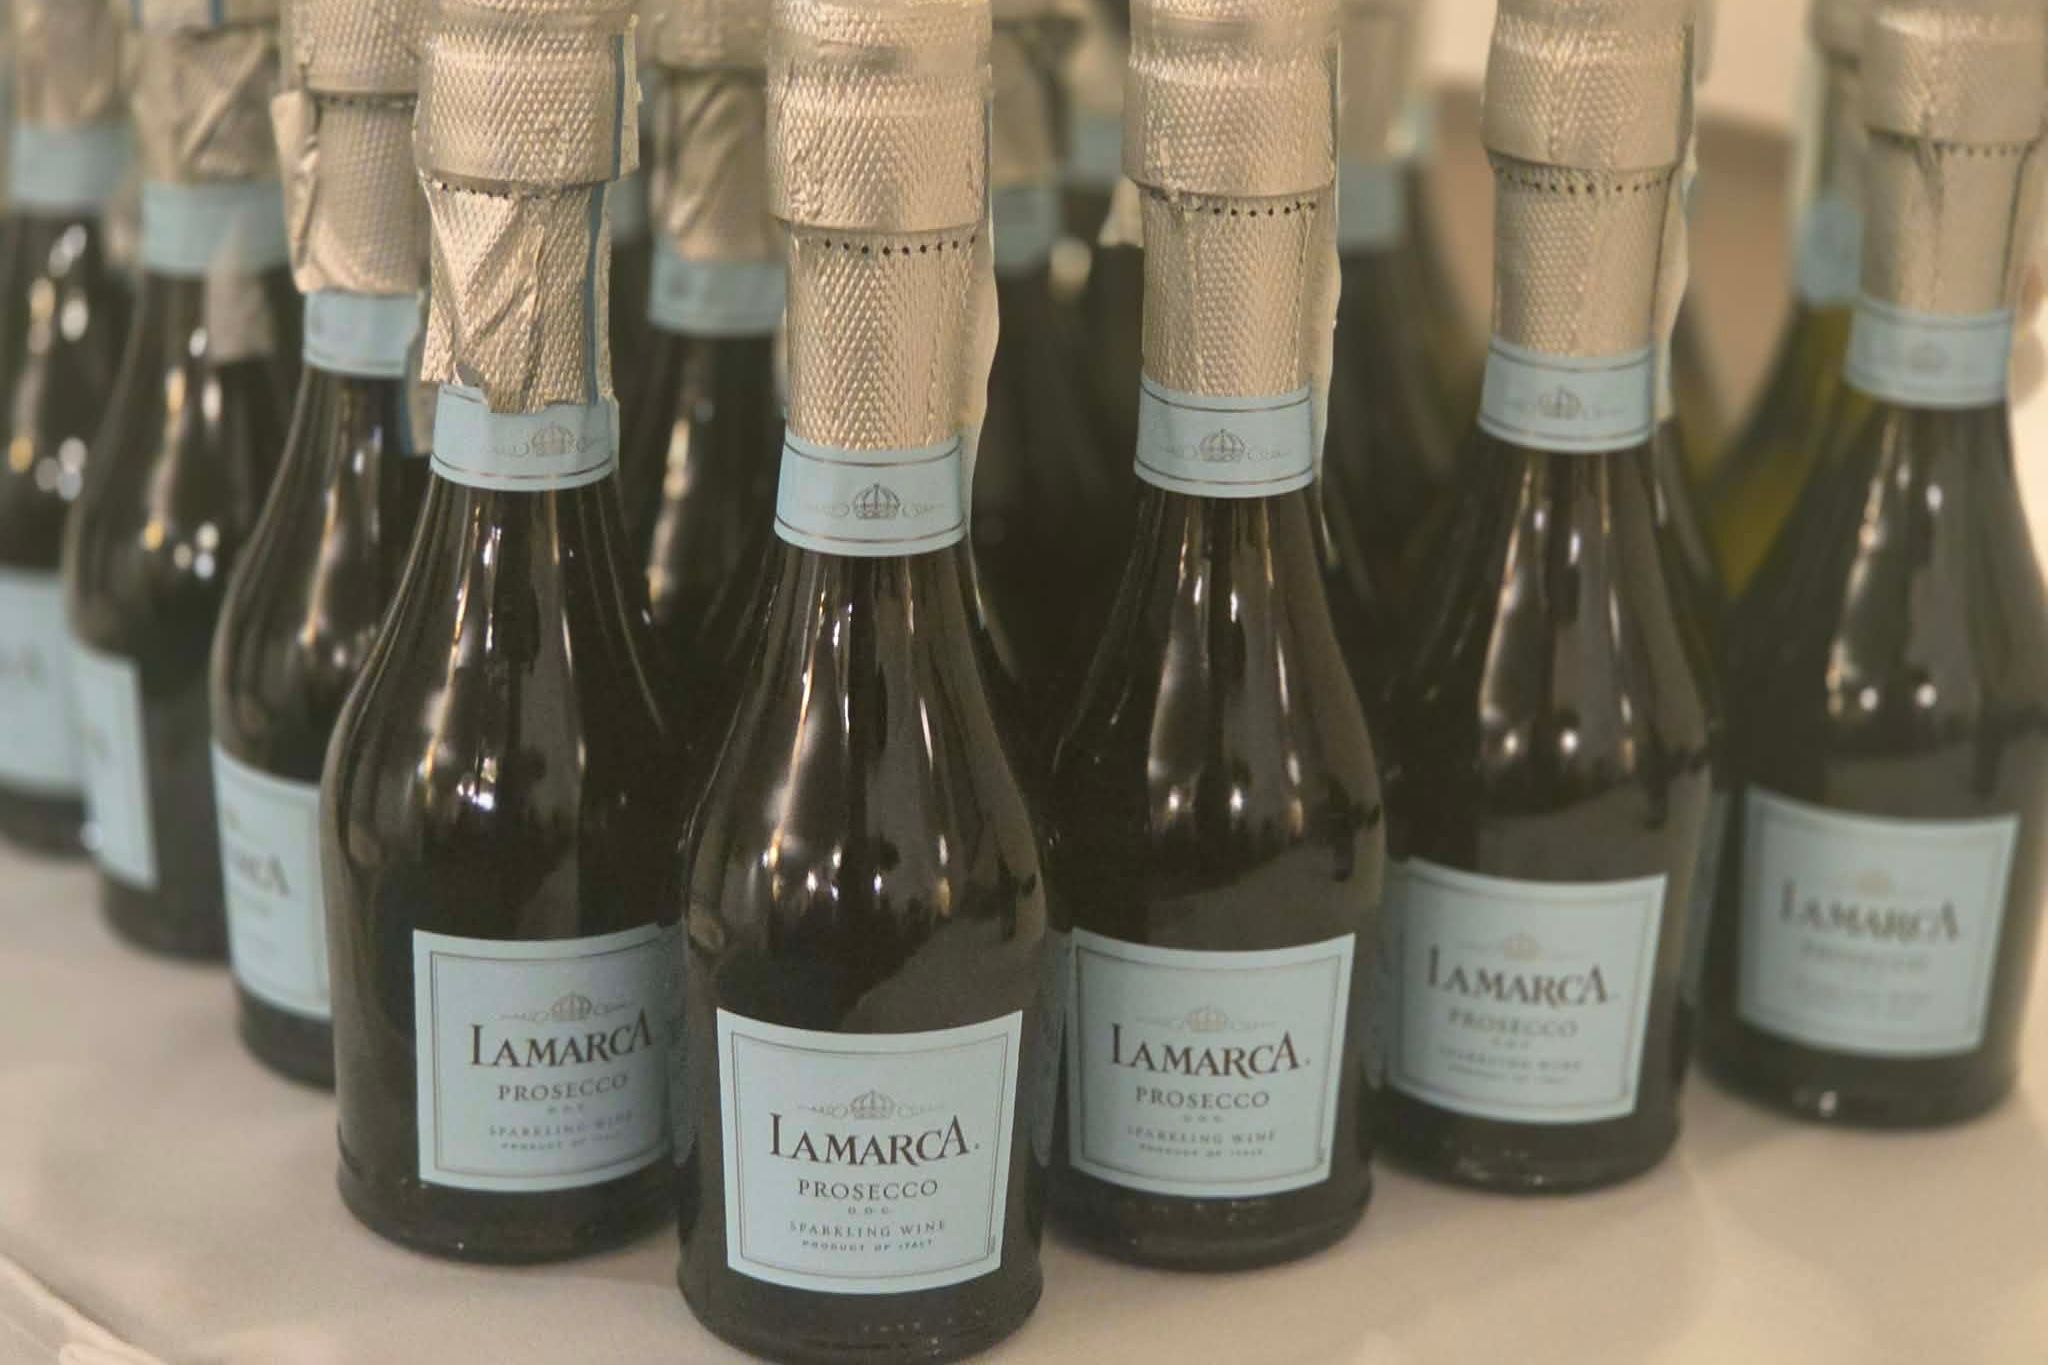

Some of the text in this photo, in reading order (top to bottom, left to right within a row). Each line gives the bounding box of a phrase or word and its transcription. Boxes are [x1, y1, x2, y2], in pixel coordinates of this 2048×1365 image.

[498, 1073, 629, 1102] PROSECCO
[1135, 1085, 1270, 1109] PROSECCO
[797, 1178, 939, 1202] PROSECCO
[789, 1219, 946, 1239] SPARKLING WINE
